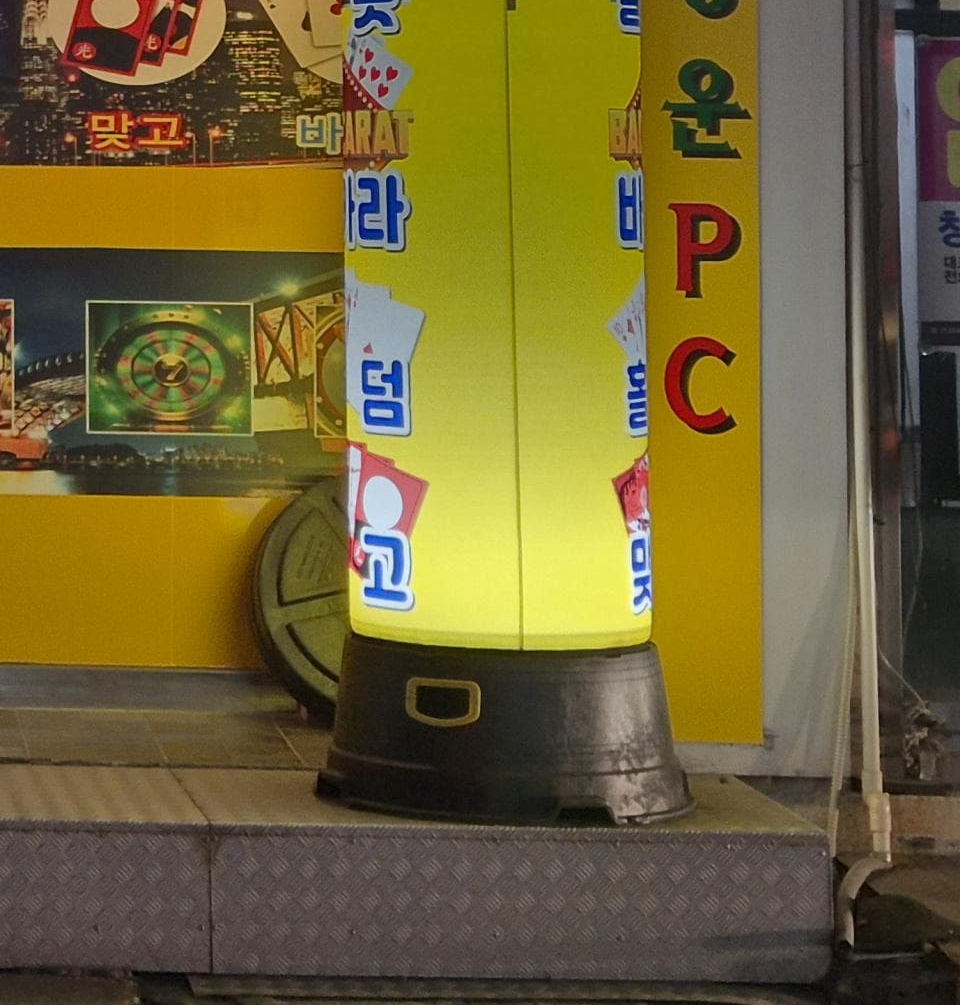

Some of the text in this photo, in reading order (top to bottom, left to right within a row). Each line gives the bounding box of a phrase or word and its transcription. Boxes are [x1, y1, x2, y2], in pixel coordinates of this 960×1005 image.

[89, 112, 185, 150] 맞고
[664, 202, 739, 435] PC
[361, 359, 406, 429] 덤
[363, 532, 409, 603] 고
